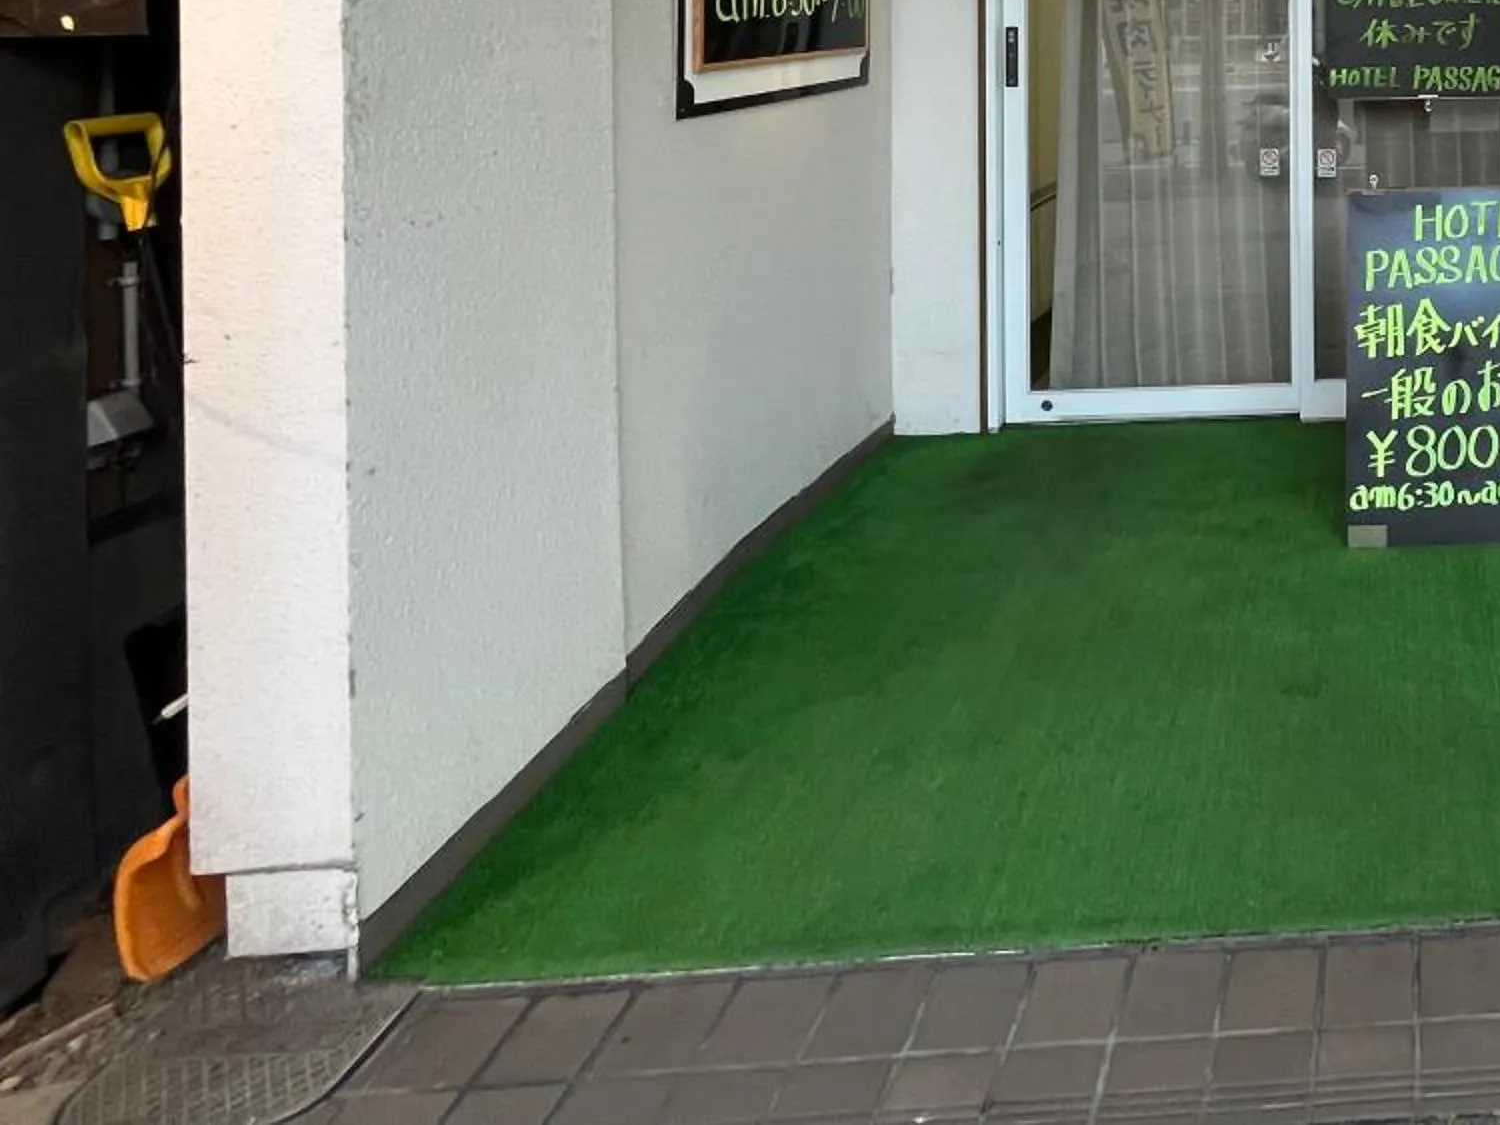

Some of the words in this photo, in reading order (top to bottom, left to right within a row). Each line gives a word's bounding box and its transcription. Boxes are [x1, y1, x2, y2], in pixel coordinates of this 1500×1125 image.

[1360, 12, 1481, 50] 休みです
[1329, 66, 1401, 88] HOTEL
